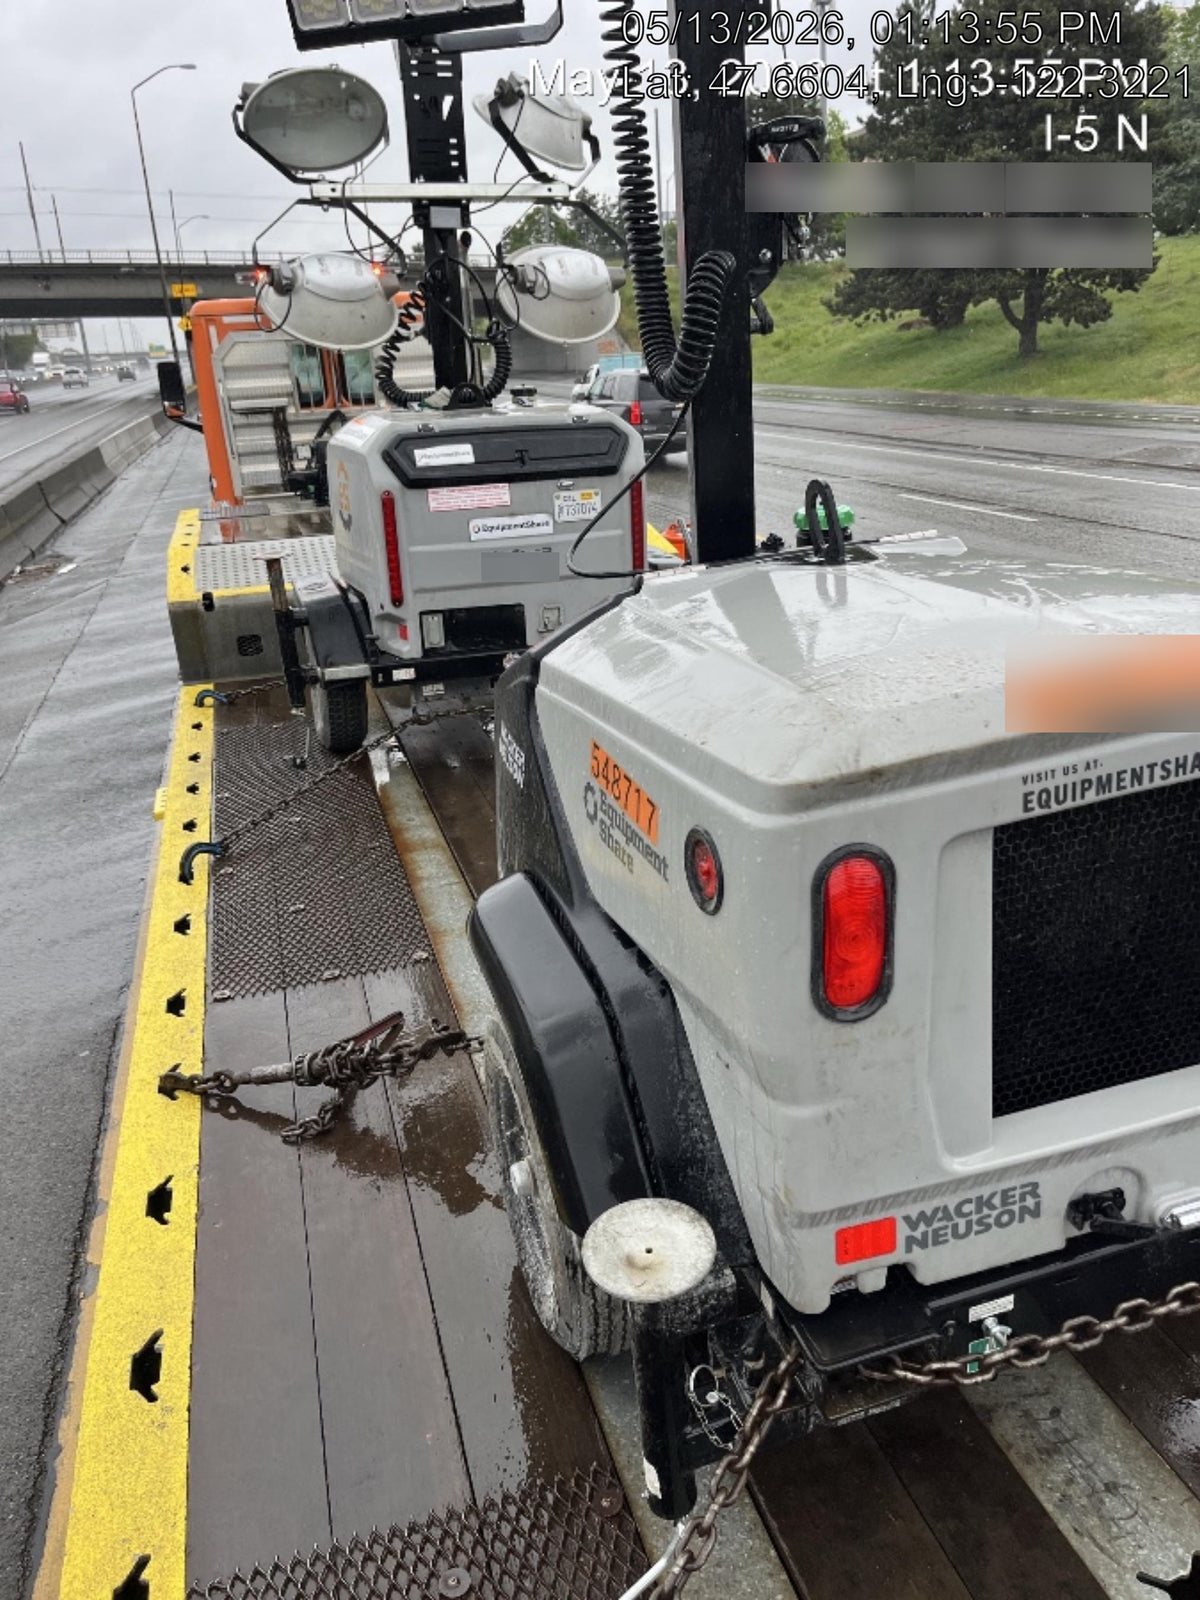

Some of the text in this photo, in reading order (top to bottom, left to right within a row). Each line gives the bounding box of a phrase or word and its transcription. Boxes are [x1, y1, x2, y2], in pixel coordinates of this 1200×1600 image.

[591, 741, 657, 837] 548717
[1022, 768, 1057, 786] VISIT
[1063, 763, 1079, 776] US
[1022, 751, 1200, 813] EQUIPMENTSHA
[600, 788, 669, 882] Equipment
[600, 818, 634, 874] Share
[901, 1181, 1042, 1233] WACKER
[905, 1199, 1041, 1255] NEUSON
